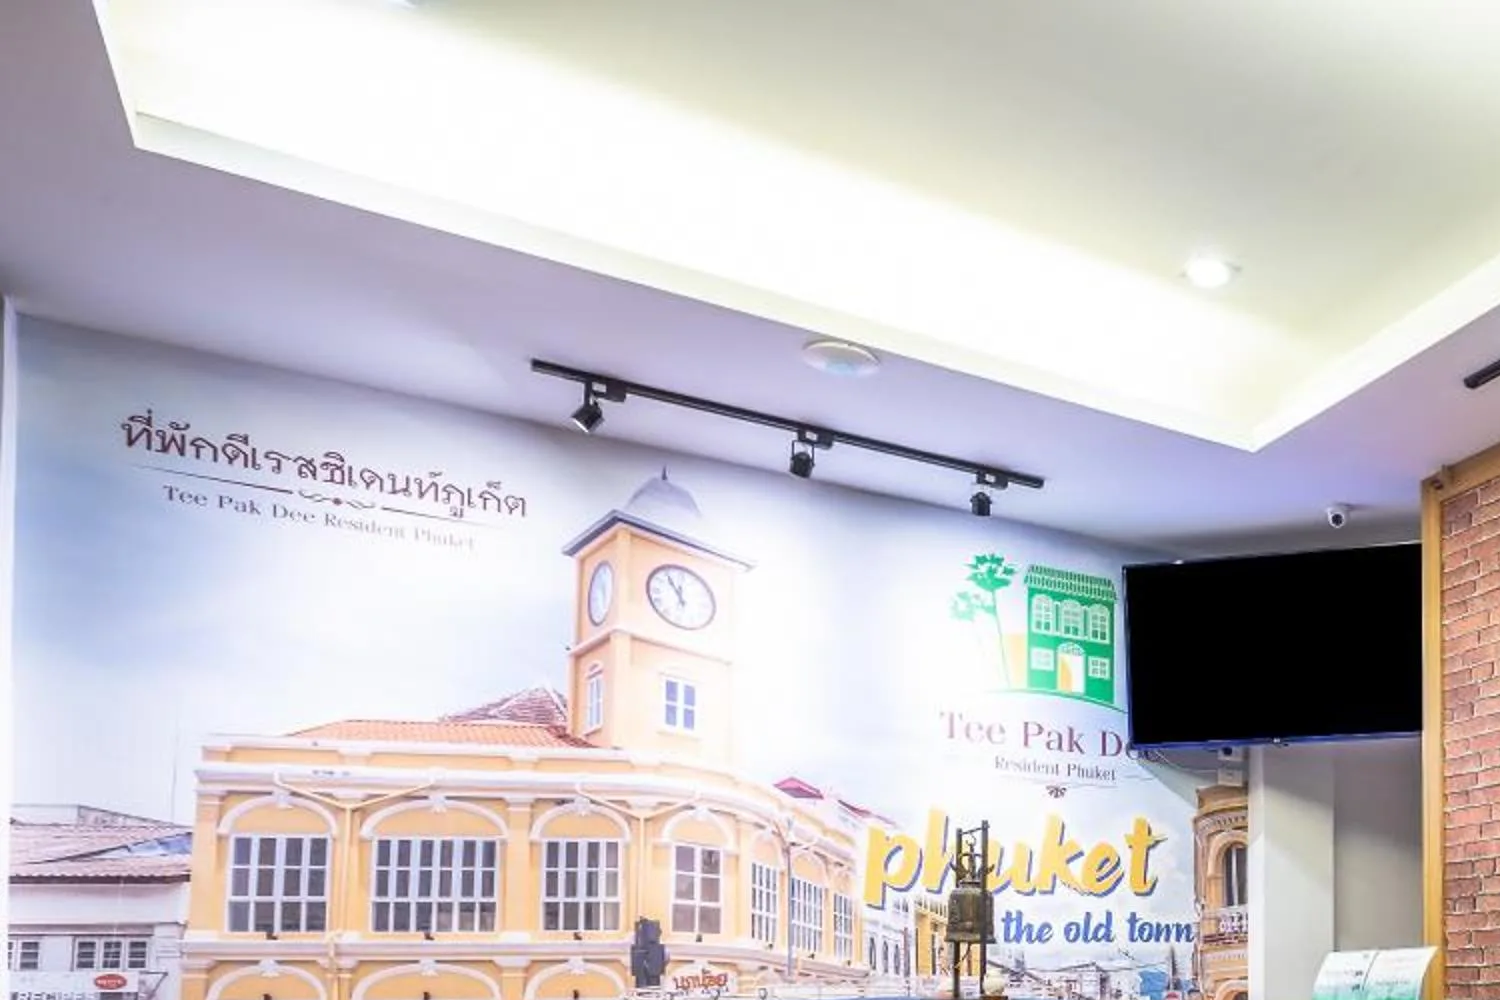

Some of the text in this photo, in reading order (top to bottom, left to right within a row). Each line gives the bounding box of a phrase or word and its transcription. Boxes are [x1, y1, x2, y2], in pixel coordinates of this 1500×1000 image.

[163, 485, 477, 550] Tee Pak Dee Resident Phuket
[939, 711, 1006, 745] Tee
[1022, 721, 1086, 755] Pak
[994, 755, 1116, 781] Resident Phuket
[1001, 909, 1195, 944] the old town
